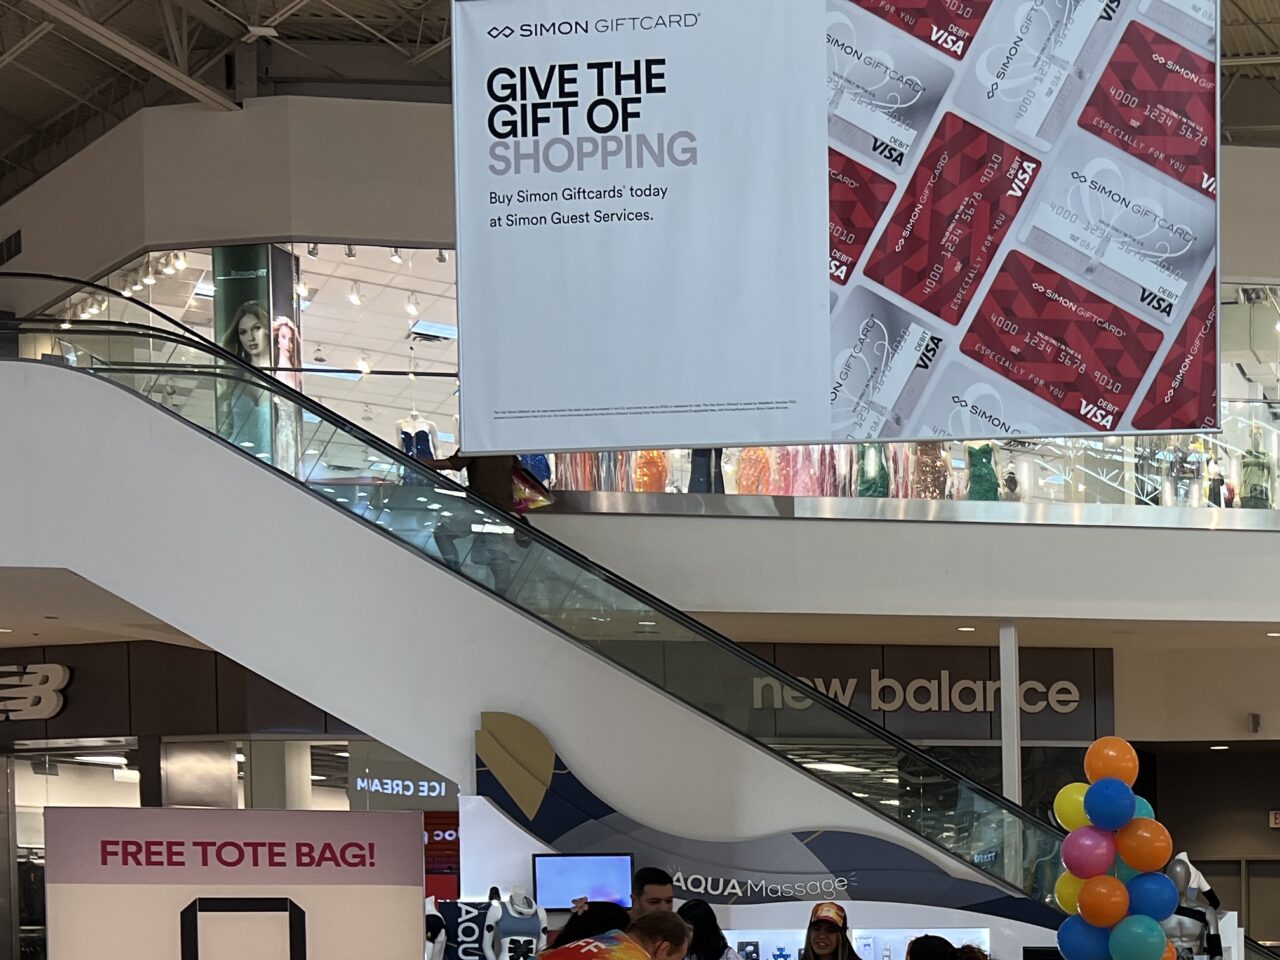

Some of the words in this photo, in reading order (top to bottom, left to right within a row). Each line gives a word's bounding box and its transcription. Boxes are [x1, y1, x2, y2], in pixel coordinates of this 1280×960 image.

[520, 20, 589, 38] SIMON
[931, 24, 966, 55] VISA
[487, 63, 579, 102] GIVE
[587, 58, 666, 96] THE
[487, 100, 579, 139] GIFT
[587, 97, 642, 134] OF
[488, 130, 698, 176] SHOPPING
[871, 137, 906, 167] VISA
[1006, 160, 1037, 199] VISA
[1088, 180, 1131, 209] SIMON
[489, 191, 513, 207] Buy
[517, 189, 558, 203] Simon
[629, 184, 668, 200] today
[489, 215, 502, 228] at
[505, 212, 547, 227] Simon
[551, 211, 590, 226] Guest
[593, 209, 653, 224] Services.
[1045, 289, 1078, 311] SIMON
[1140, 287, 1174, 317] VISA
[991, 313, 1019, 335] 4000
[1024, 332, 1052, 353] 1234
[915, 336, 943, 370] VISA
[975, 343, 1025, 375] ESPECIALLY
[1028, 374, 1045, 387] FOR
[1050, 385, 1065, 399] YOU
[1079, 398, 1115, 429] VISA
[1097, 398, 1120, 413] DEBIT
[753, 676, 858, 710] new
[100, 840, 186, 867] FREE
[192, 841, 287, 868] TOTE
[295, 842, 376, 868] BAG!
[673, 871, 743, 897] AQUA
[747, 877, 848, 899] Massage
